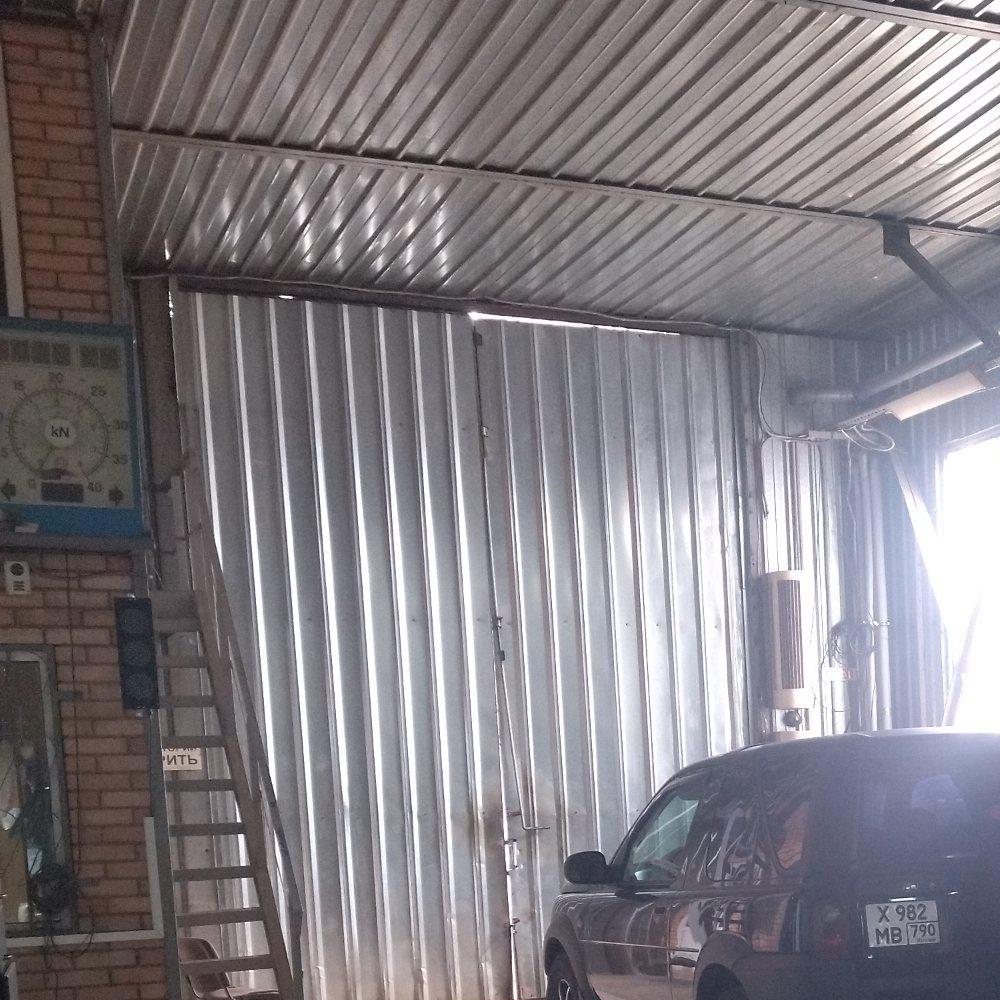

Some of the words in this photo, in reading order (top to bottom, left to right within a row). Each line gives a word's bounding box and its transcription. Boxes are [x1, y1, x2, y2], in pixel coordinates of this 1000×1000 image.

[48, 372, 64, 384] 20
[51, 425, 70, 438] kN
[896, 903, 927, 922] 982
[875, 927, 902, 945] МВ
[910, 923, 936, 938] 790
